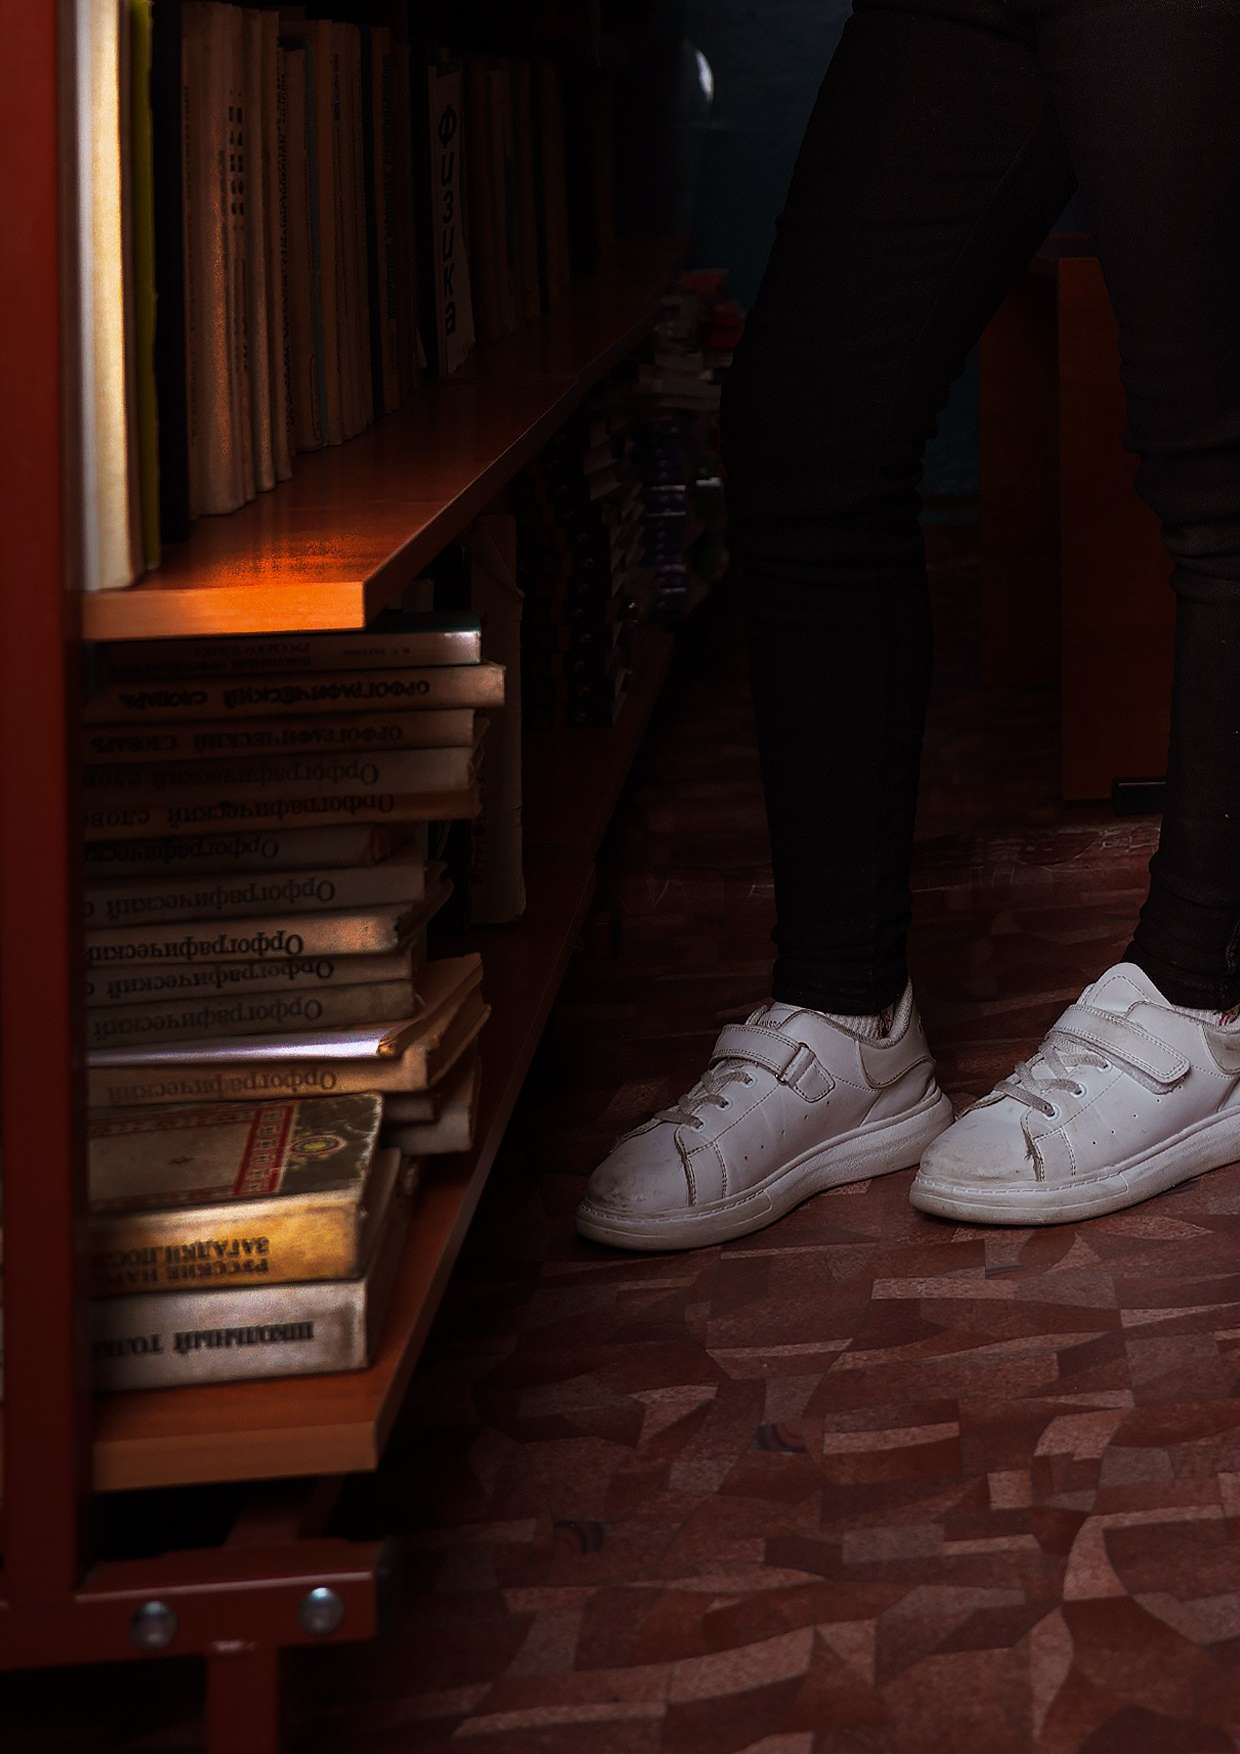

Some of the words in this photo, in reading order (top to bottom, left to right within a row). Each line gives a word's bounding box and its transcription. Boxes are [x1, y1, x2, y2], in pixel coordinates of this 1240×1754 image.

[106, 879, 335, 924] Орфографический
[93, 999, 324, 1042] Орфографический
[163, 1236, 270, 1262] ЗАГАДКИ
[167, 1258, 269, 1283] РУССКИЕ
[174, 1320, 314, 1355] ШКОЛЬНЫЙ
